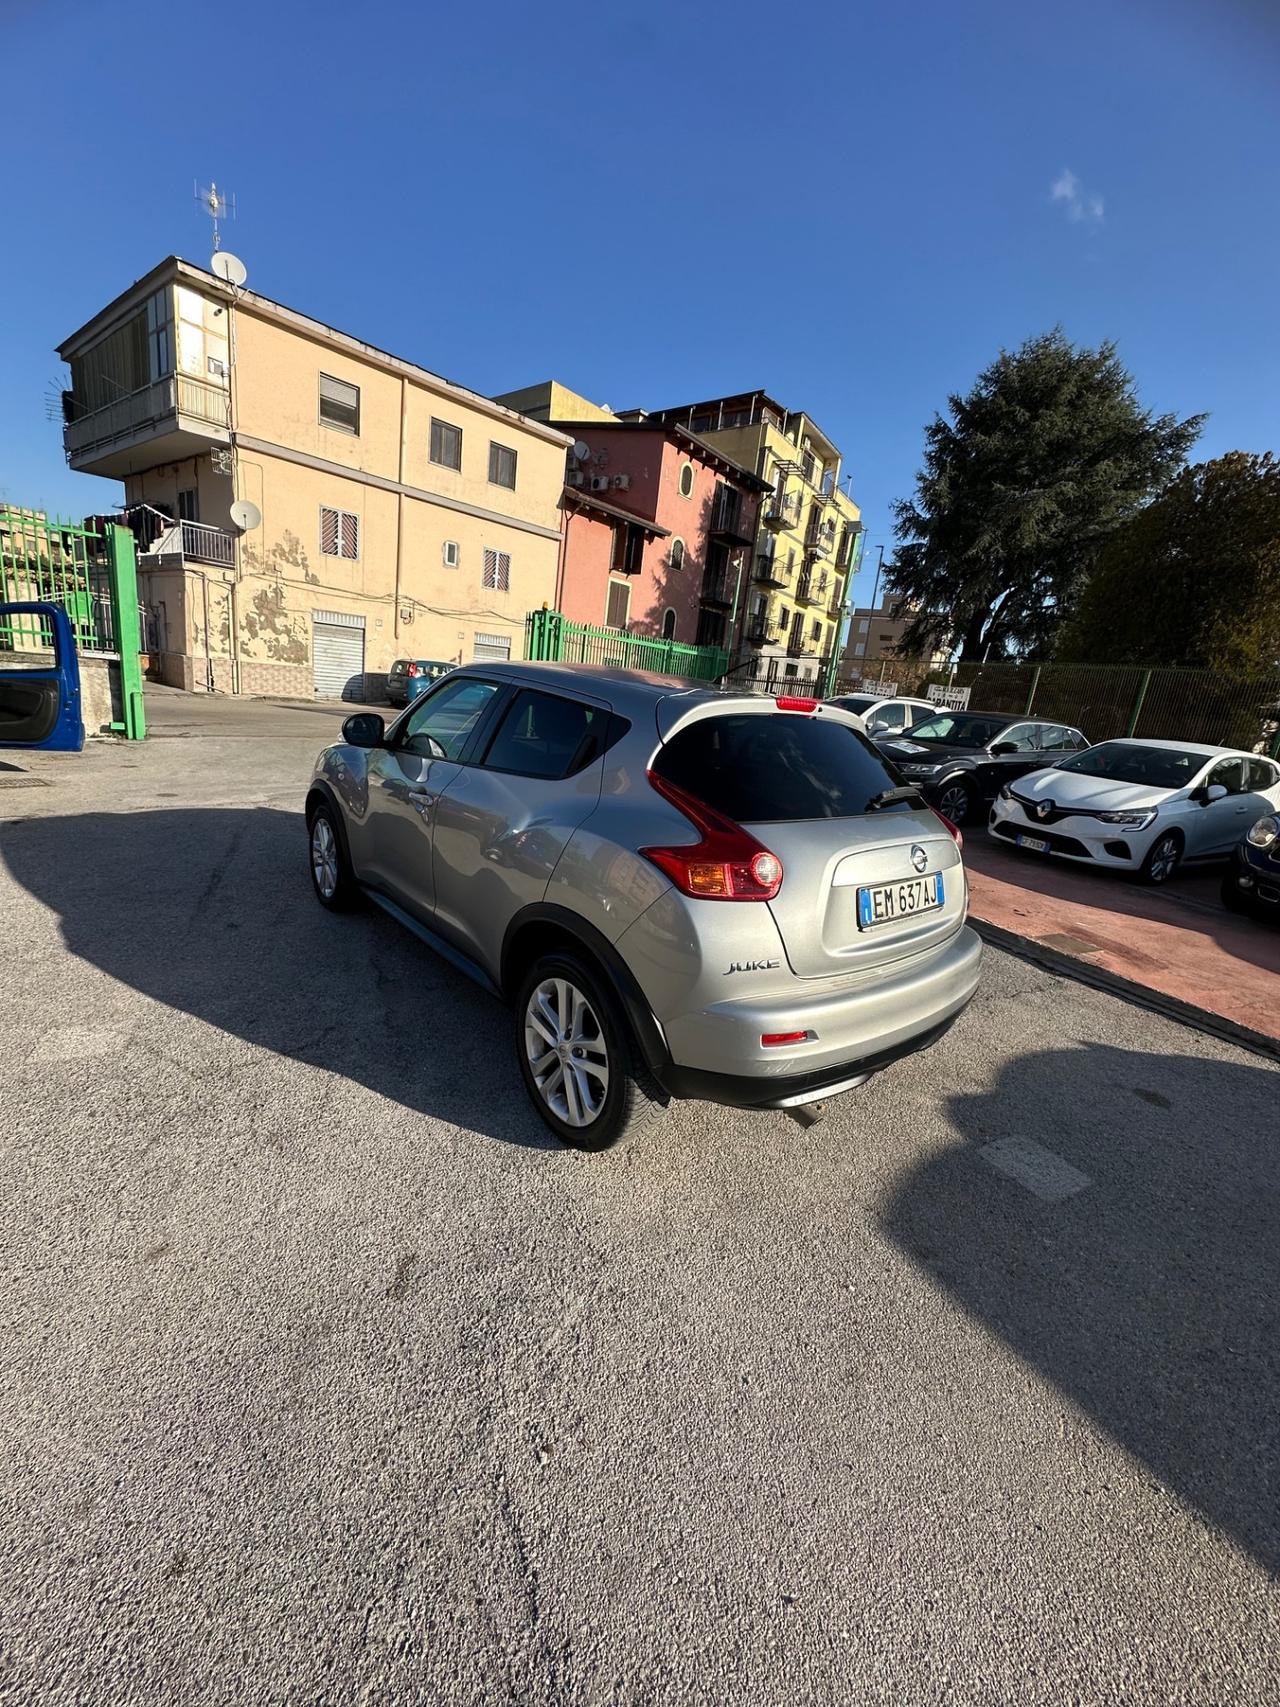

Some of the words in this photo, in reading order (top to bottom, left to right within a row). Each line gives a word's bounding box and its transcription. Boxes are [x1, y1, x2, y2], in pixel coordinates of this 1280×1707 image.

[873, 888, 894, 919] EM
[899, 878, 937, 912] 637AJ
[722, 959, 781, 976] JUKE
